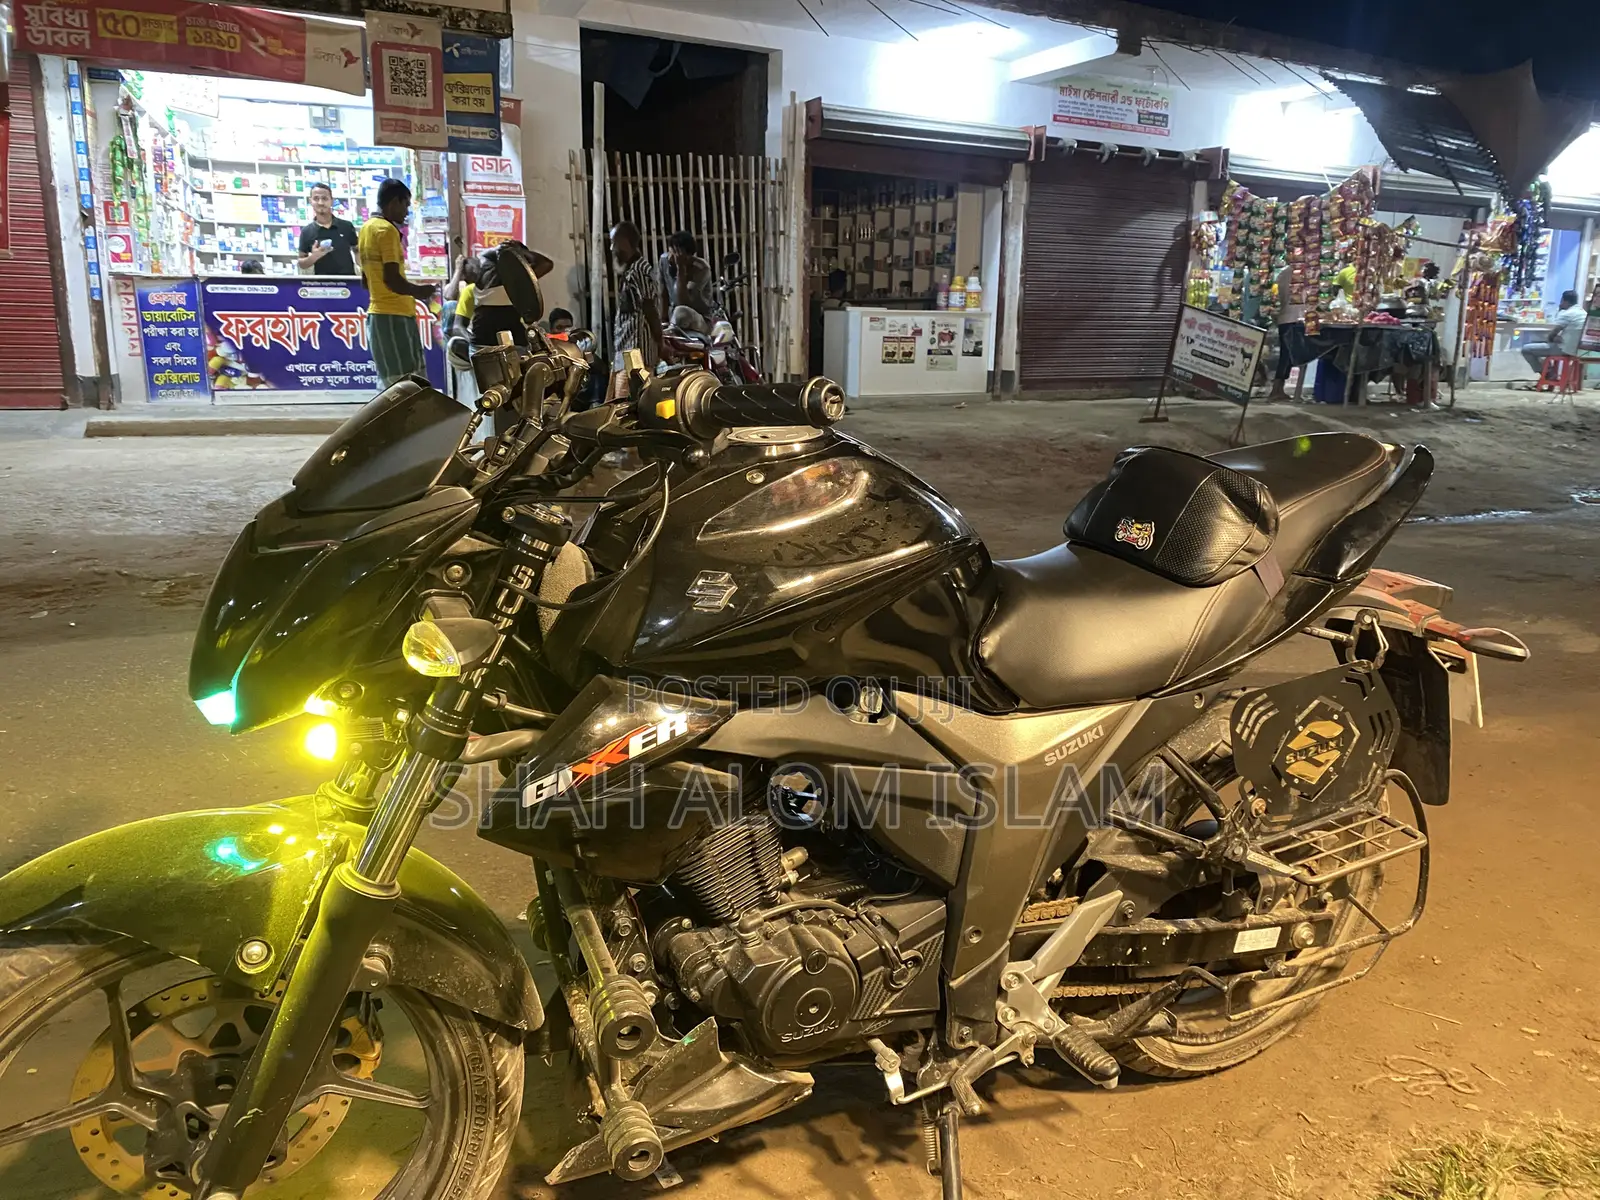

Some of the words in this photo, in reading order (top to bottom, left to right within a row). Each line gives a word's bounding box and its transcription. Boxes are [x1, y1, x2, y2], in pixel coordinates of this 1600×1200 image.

[22, 1, 89, 29] সুবিধা
[100, 11, 140, 38] ৫০
[25, 26, 91, 49] ডাবল
[444, 80, 492, 96] ফ্লেক্সিলোড
[451, 95, 470, 107] করা
[472, 97, 485, 107] হয়
[471, 156, 513, 174] নগদ
[147, 291, 187, 307] প্রেসার
[142, 307, 197, 323] ডায়াবেটিস
[143, 324, 168, 338] পরীক্ষা
[170, 326, 186, 337] করা
[187, 326, 199, 338] হয়
[213, 306, 325, 356] ফরহাদ
[164, 341, 183, 352] এবং
[151, 355, 172, 367] সকল
[173, 353, 197, 366] সিমের
[285, 361, 317, 373] এখানে
[153, 369, 201, 385] ফ্লেক্সিলোড
[298, 375, 324, 387] সুলভ
[325, 375, 350, 388] মূল্যে
[1043, 724, 1105, 768] SUZUKI
[1285, 737, 1344, 765] SUZUKI
[780, 1019, 840, 1043] SUZUKI
